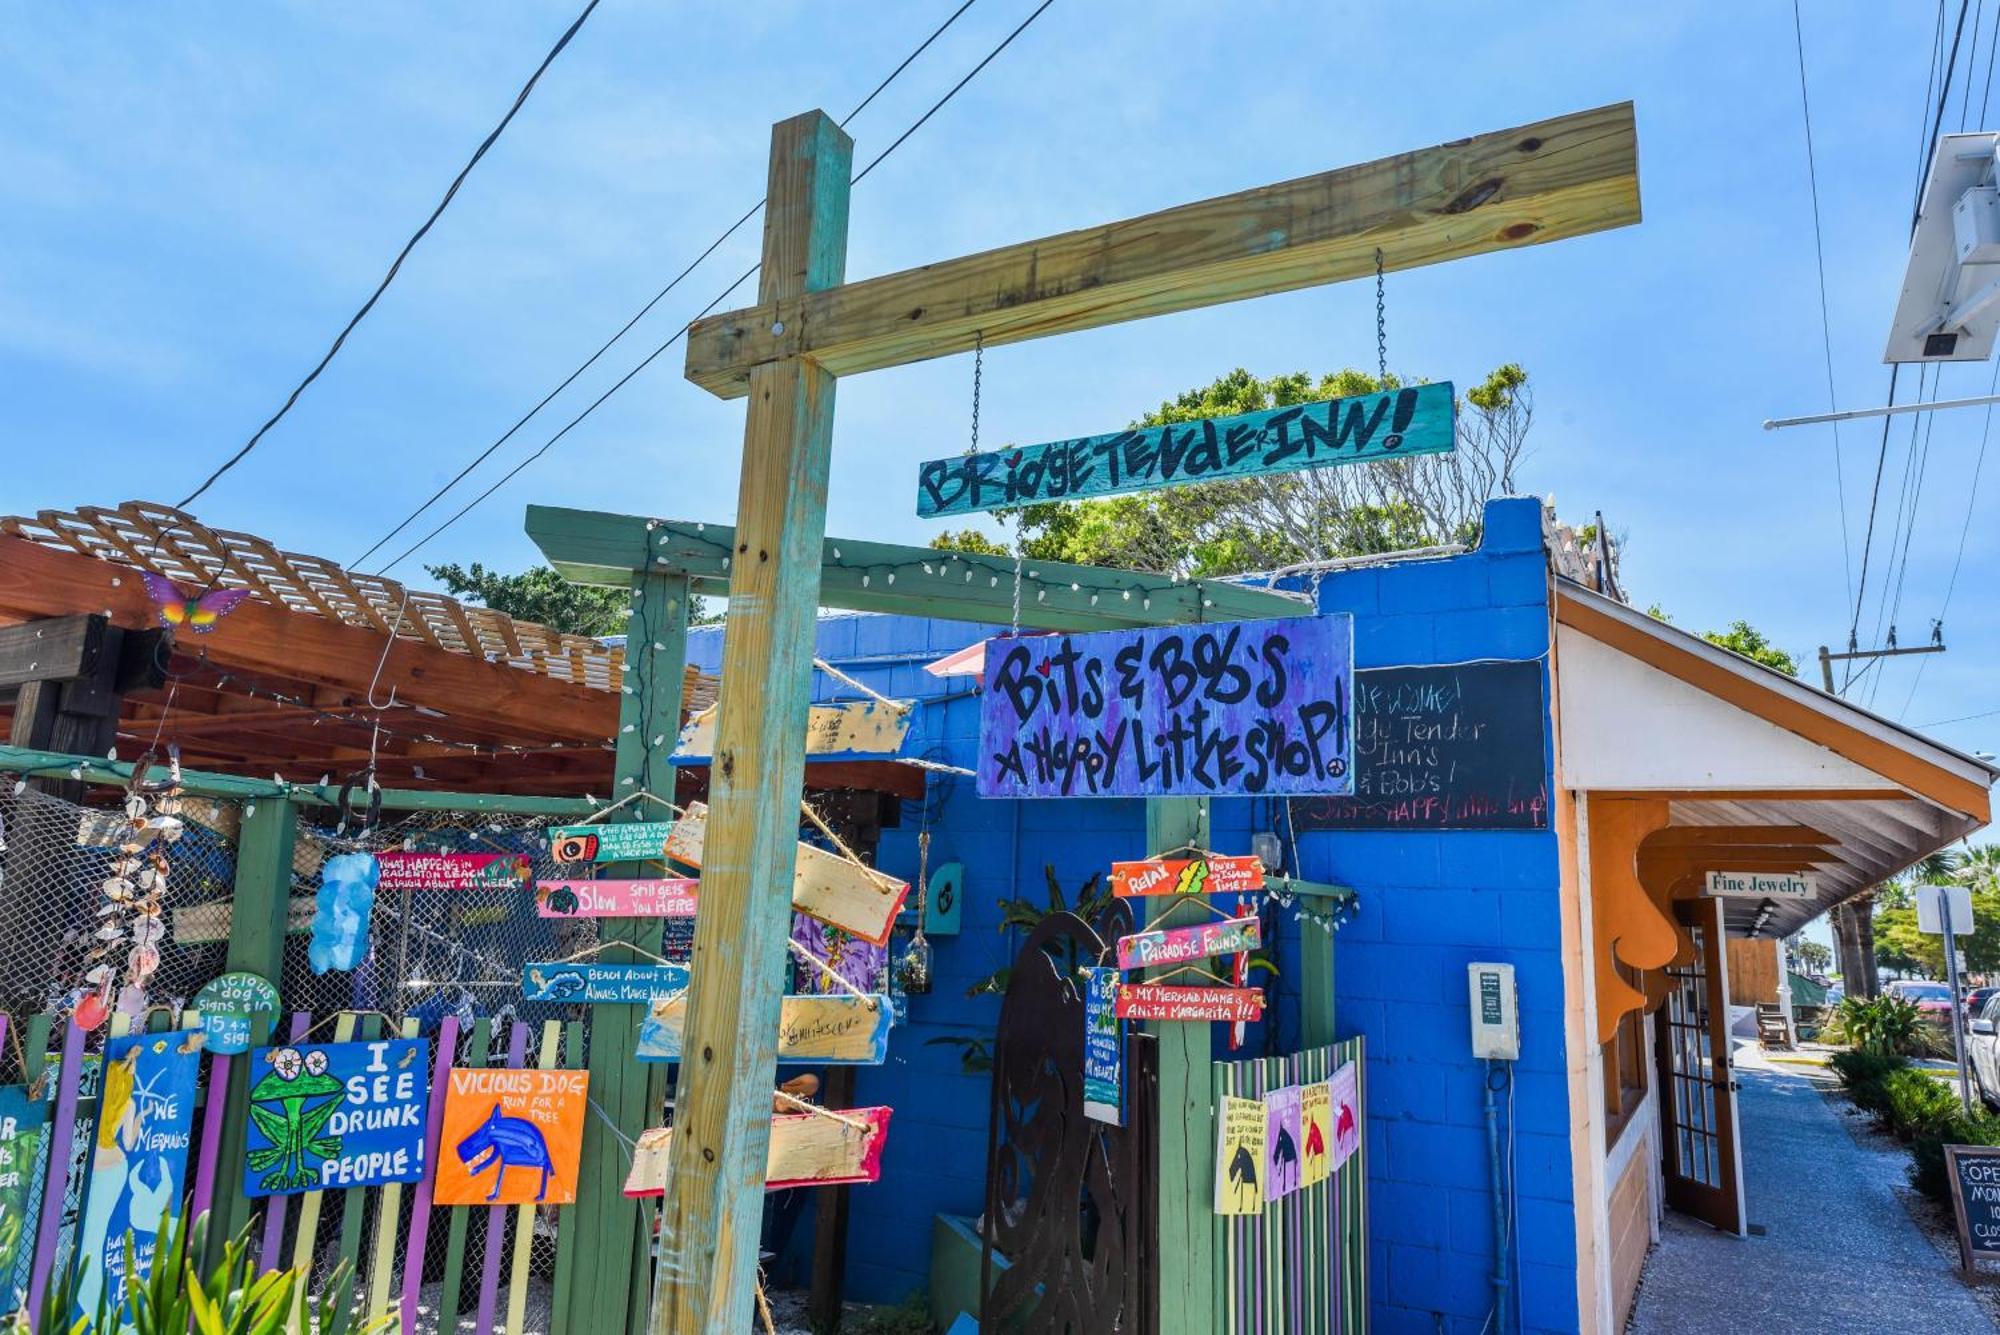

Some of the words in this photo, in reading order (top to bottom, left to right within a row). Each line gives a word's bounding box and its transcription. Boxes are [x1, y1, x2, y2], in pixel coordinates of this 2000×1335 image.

[1115, 636, 1145, 710] &
[1401, 714, 1487, 743] Tender
[993, 741, 1028, 785] A
[1376, 743, 1438, 767] Inn's
[1387, 794, 1450, 823] HAPPY
[656, 832, 669, 840] DA
[379, 857, 405, 869] WHAT
[406, 857, 460, 871] HAPPENS
[379, 869, 441, 879] RADENTON
[424, 879, 457, 888] ABOUT
[1712, 875, 1744, 891] Fine
[1749, 876, 1808, 897] Jewelry
[655, 899, 695, 913] HERE
[1203, 929, 1240, 952] FOUND
[587, 968, 621, 981] BEACH
[221, 987, 253, 1001] dog
[620, 986, 648, 1000] MAKE
[1135, 988, 1154, 1001] MY
[1155, 986, 1201, 1003] MERMAID
[1202, 991, 1234, 1004] NAME
[366, 1042, 389, 1073] I
[347, 1072, 413, 1104] SEE
[452, 1072, 532, 1096] VICIOUS
[539, 1074, 586, 1095] DOG
[154, 1099, 179, 1121] WE
[502, 1096, 526, 1109] RUN
[531, 1096, 551, 1109] FOR
[557, 1097, 565, 1108] A
[329, 1104, 421, 1136] DRUNK
[528, 1109, 560, 1125] TREE
